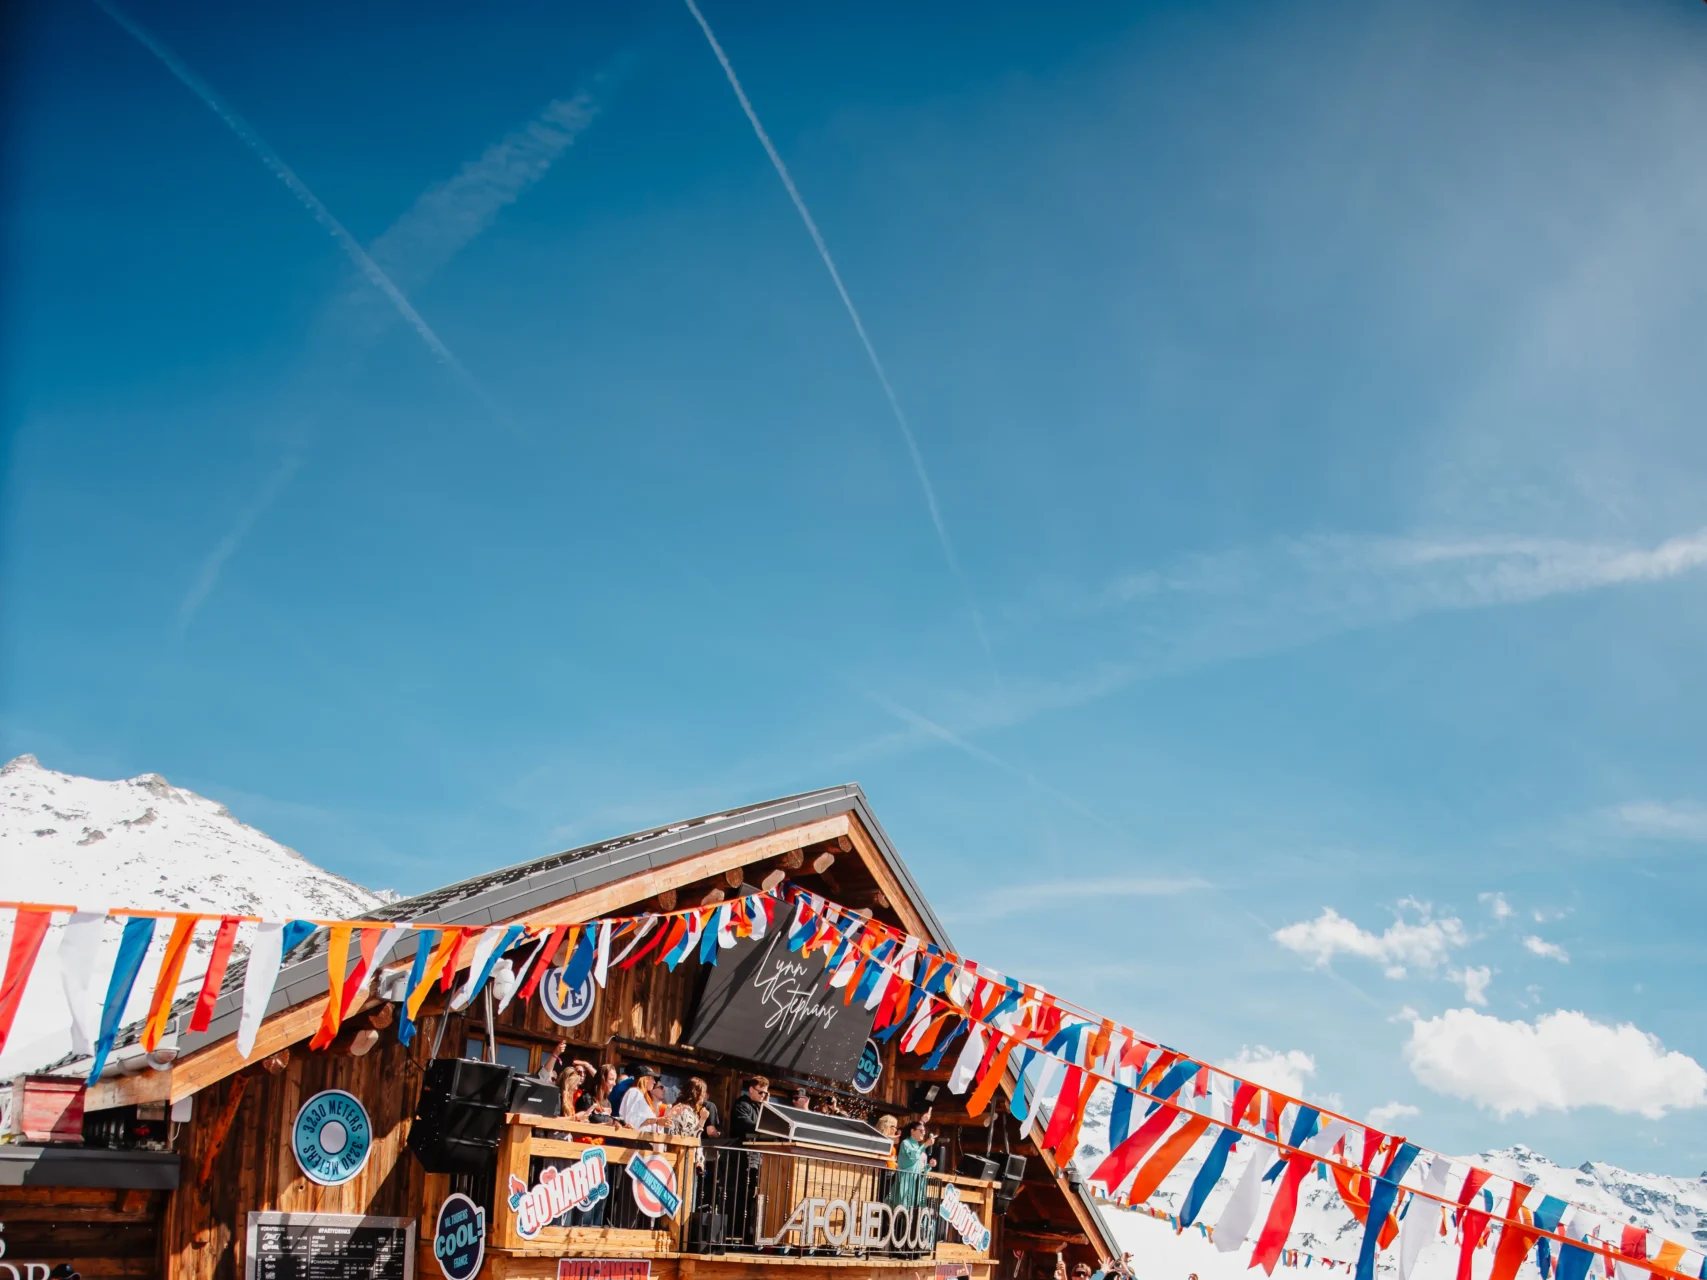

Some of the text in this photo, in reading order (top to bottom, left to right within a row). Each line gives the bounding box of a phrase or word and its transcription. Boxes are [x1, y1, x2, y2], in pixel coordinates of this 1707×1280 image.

[754, 931, 808, 1005] Lynn
[303, 1100, 363, 1133] 3230 METERS
[303, 1141, 363, 1175] 3230 METERS
[436, 1212, 483, 1258] COOL!
